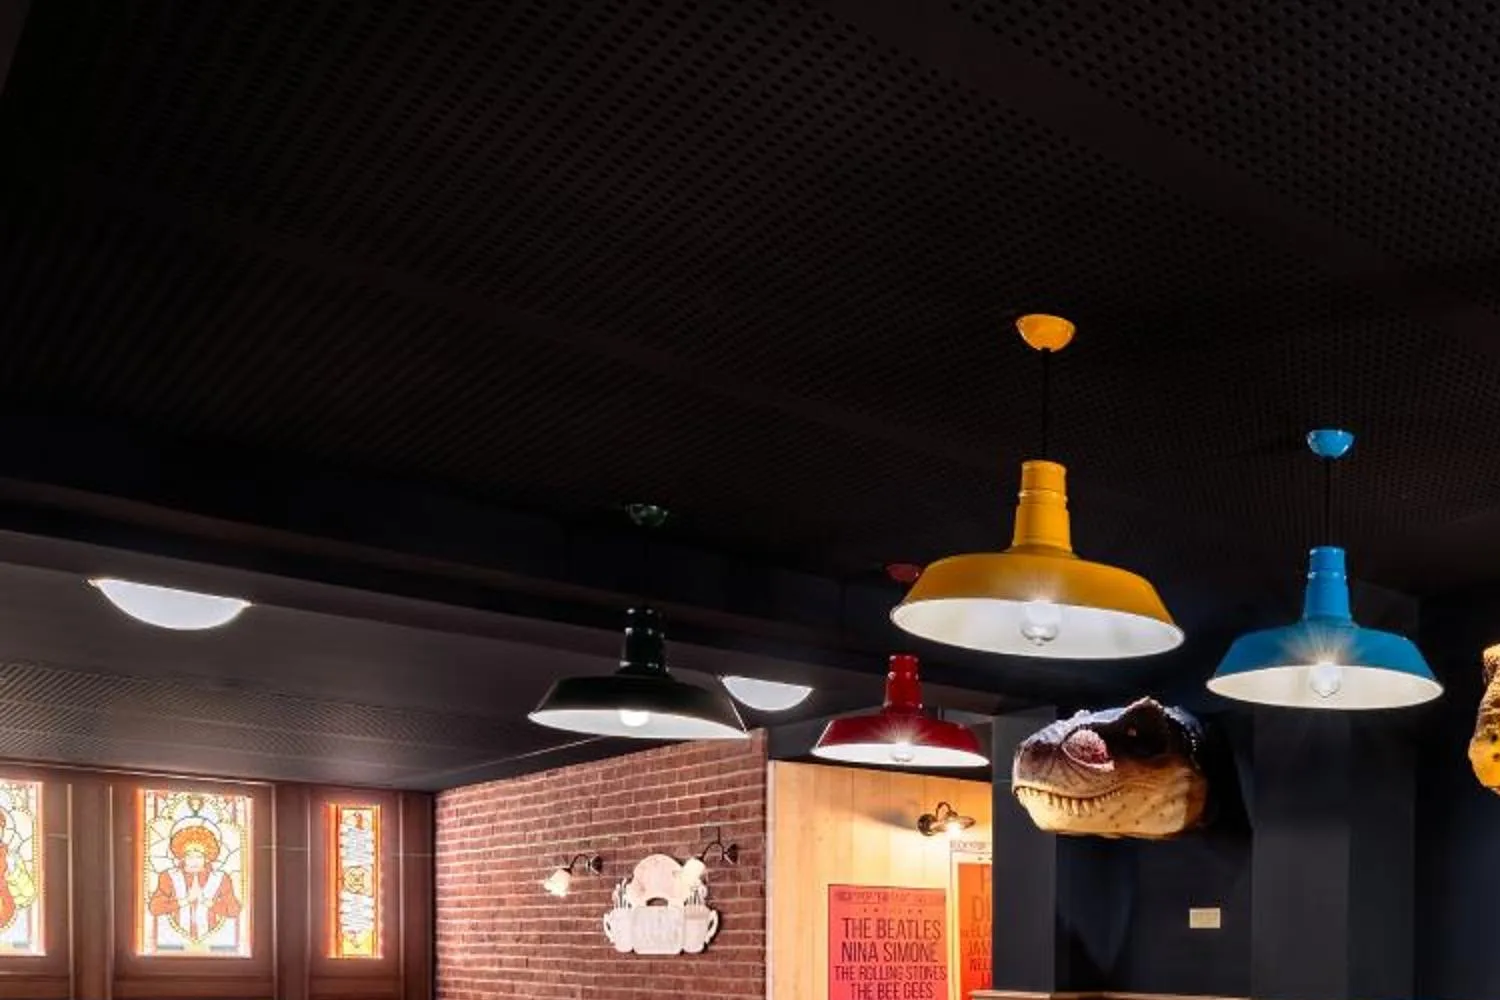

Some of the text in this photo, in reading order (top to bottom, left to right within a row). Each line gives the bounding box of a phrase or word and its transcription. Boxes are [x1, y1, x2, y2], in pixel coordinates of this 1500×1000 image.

[841, 917, 872, 939] THE
[876, 917, 942, 940] BEATLES
[841, 941, 938, 963] NINA SIMONE
[834, 965, 947, 981] THE ROLLING STONES
[850, 982, 934, 1000] THE BEE GEES
